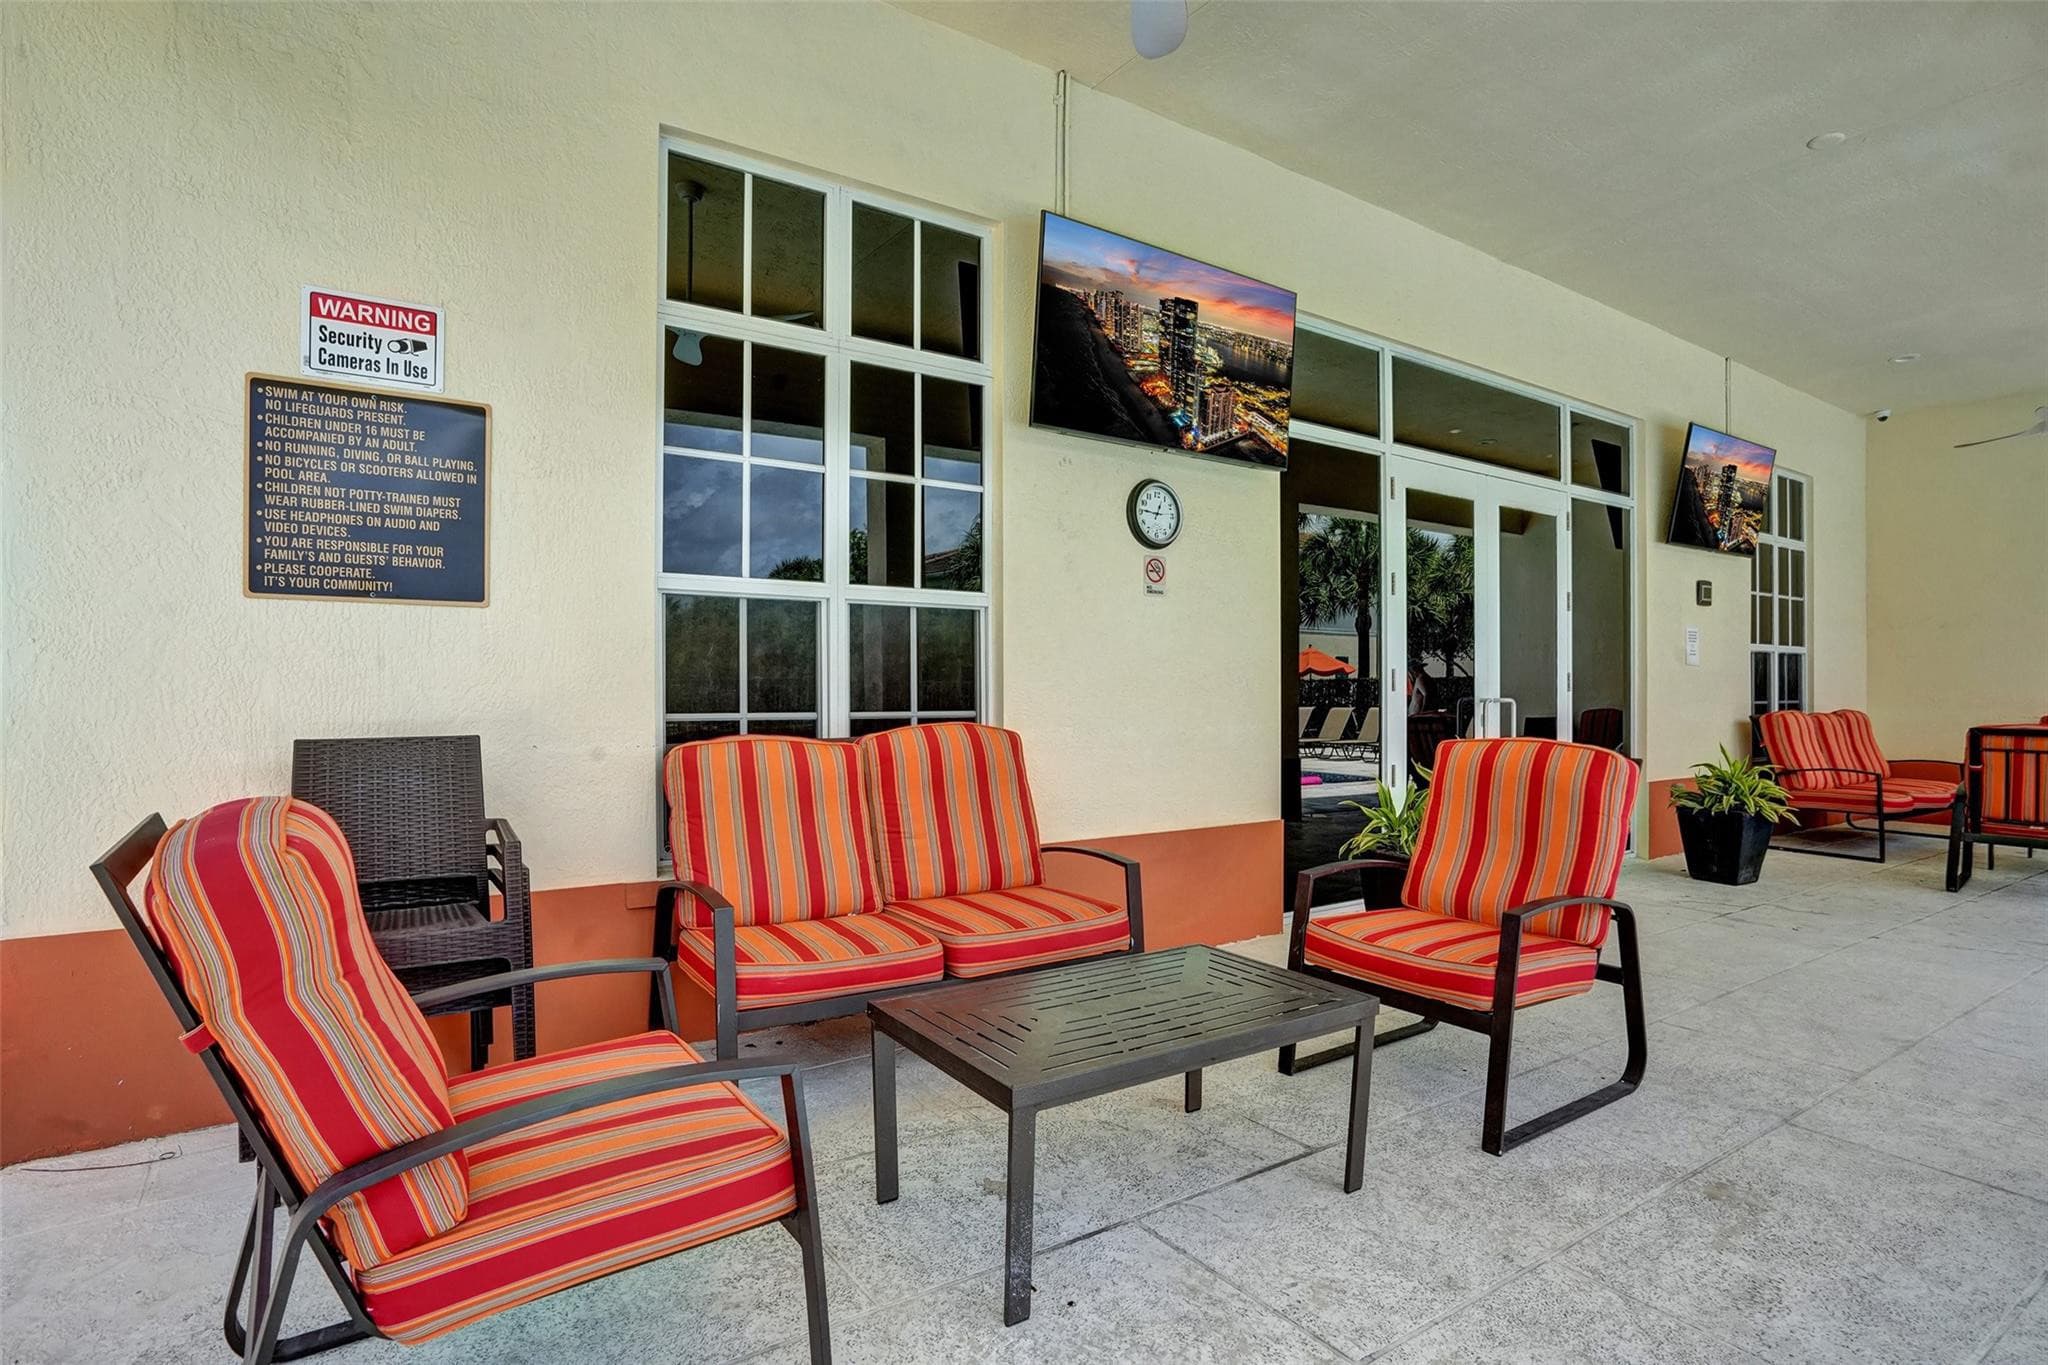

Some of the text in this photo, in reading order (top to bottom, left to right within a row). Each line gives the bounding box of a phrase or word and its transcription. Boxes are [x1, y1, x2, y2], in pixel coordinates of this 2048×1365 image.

[318, 297, 431, 332] WARNING
[319, 324, 382, 354] Security
[318, 347, 381, 373] Cameras
[386, 358, 399, 375] In
[404, 360, 428, 379] Use
[265, 385, 407, 413] SWIM AT YOUR OWN RISK.
[265, 399, 406, 425] NO LIFEGUARDS PRESENT.
[265, 413, 425, 441] CHILDREN UNDER 16 MUST BE
[265, 426, 418, 452] ACCOMPANIED BY AN ADULT.
[265, 441, 281, 451] NO
[387, 453, 401, 463] OR
[404, 455, 429, 467] BALL
[432, 458, 477, 472] PLAYING.
[265, 454, 477, 484] NO BICYCLES OR SCOOTERS ALLOWED IN
[264, 467, 331, 483] POOL AREA.
[264, 482, 461, 508] CHILDREN NOT POTTY-TRAINED MUST
[264, 494, 462, 520] WEAR RUBBER-LINED SWIM DIAPERS.
[264, 508, 440, 531] USE HEADPHONES ON AUDIO AND
[264, 521, 351, 538] VIDEO DEVICES.
[264, 535, 444, 557] YOU ARE RESPONSIBLE FOR YOUR
[264, 549, 446, 569] FAMILY'S AND GUESTS' BEHAVIOR.
[264, 562, 376, 579] PLEASE COOPERATE.
[264, 576, 393, 592] IT'S YOUR COMMUNITY!
